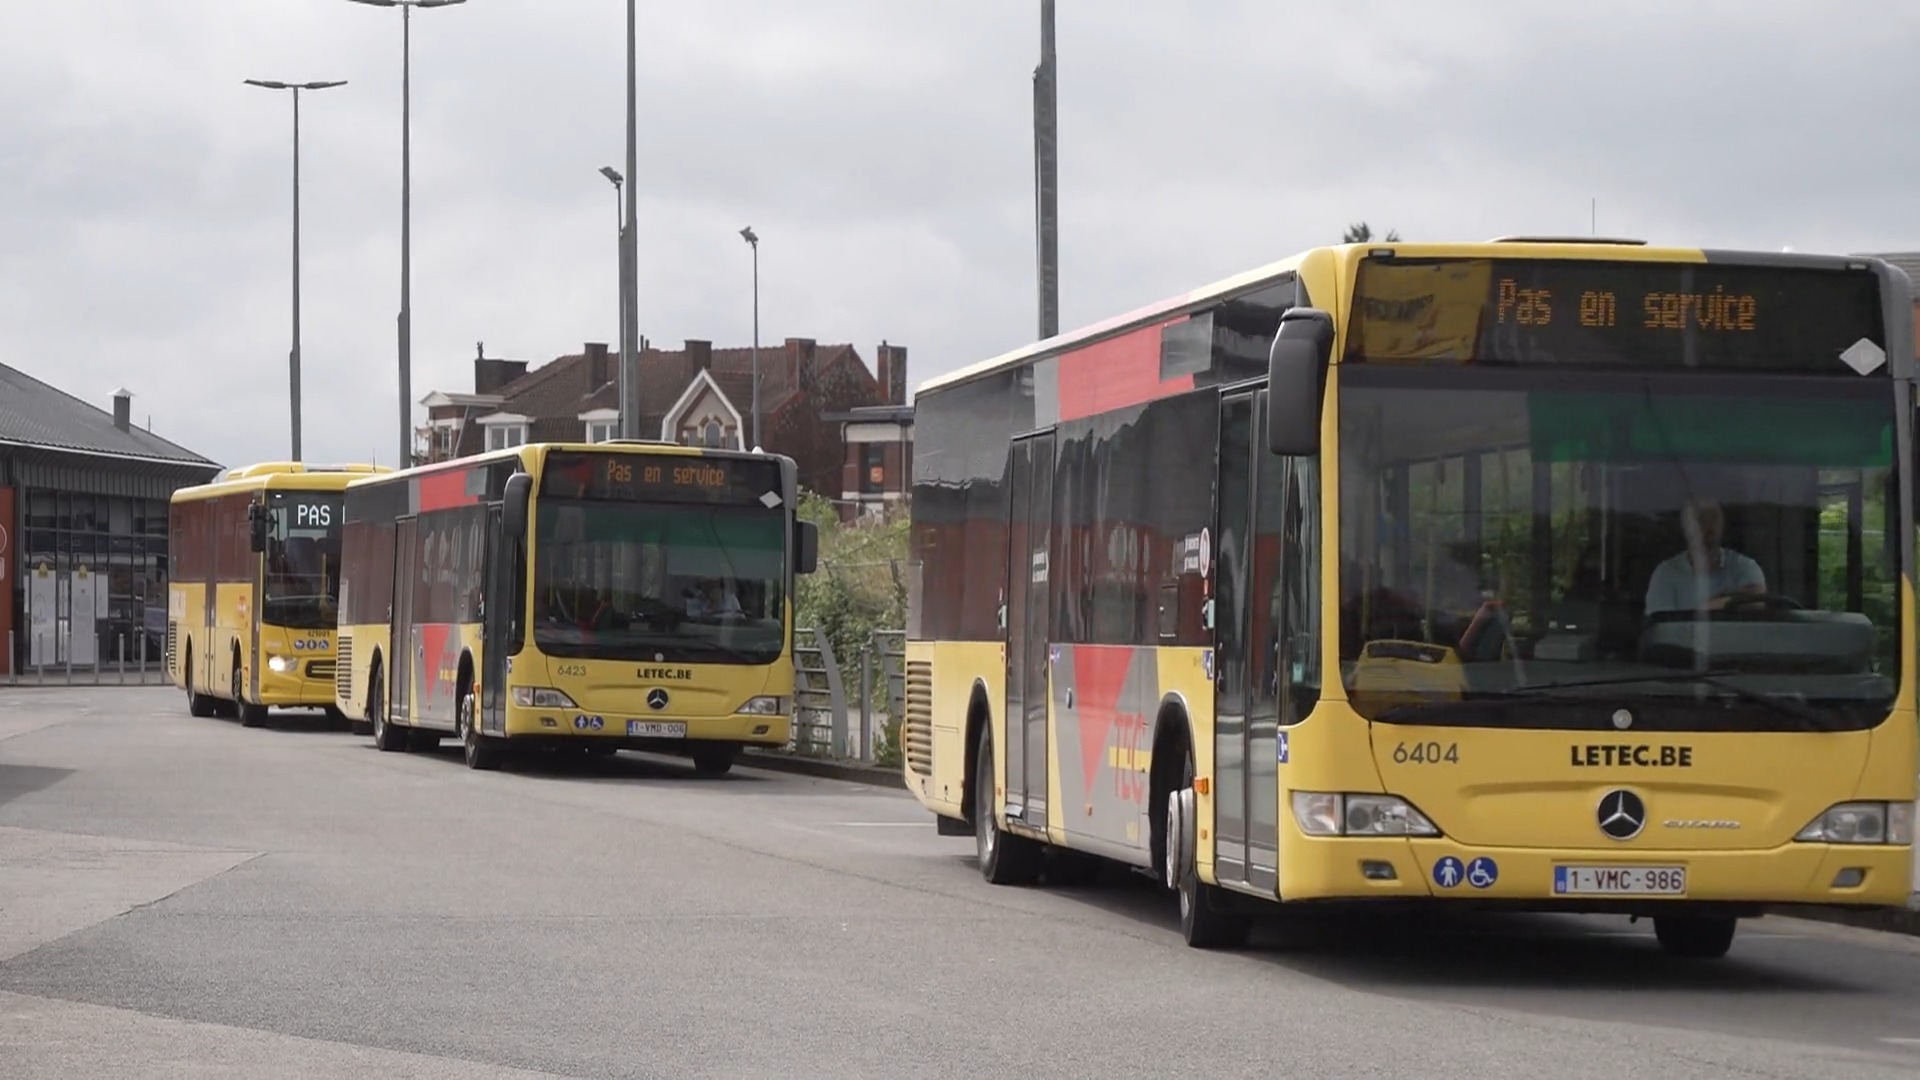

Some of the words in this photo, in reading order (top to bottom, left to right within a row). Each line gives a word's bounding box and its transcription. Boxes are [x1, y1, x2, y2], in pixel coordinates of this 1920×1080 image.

[1498, 279, 1551, 325] Pas
[1581, 291, 1615, 327] en
[1644, 285, 1756, 331] service
[607, 460, 632, 482] Pas
[644, 465, 661, 482] en
[673, 464, 724, 485] service
[297, 504, 331, 526] PAS
[557, 665, 587, 676] 6423
[636, 668, 692, 680] LETEC.BE
[1392, 741, 1460, 764] 6404
[1570, 745, 1693, 767] LETEC.BE
[1571, 870, 1683, 891] 1-VMC-986
